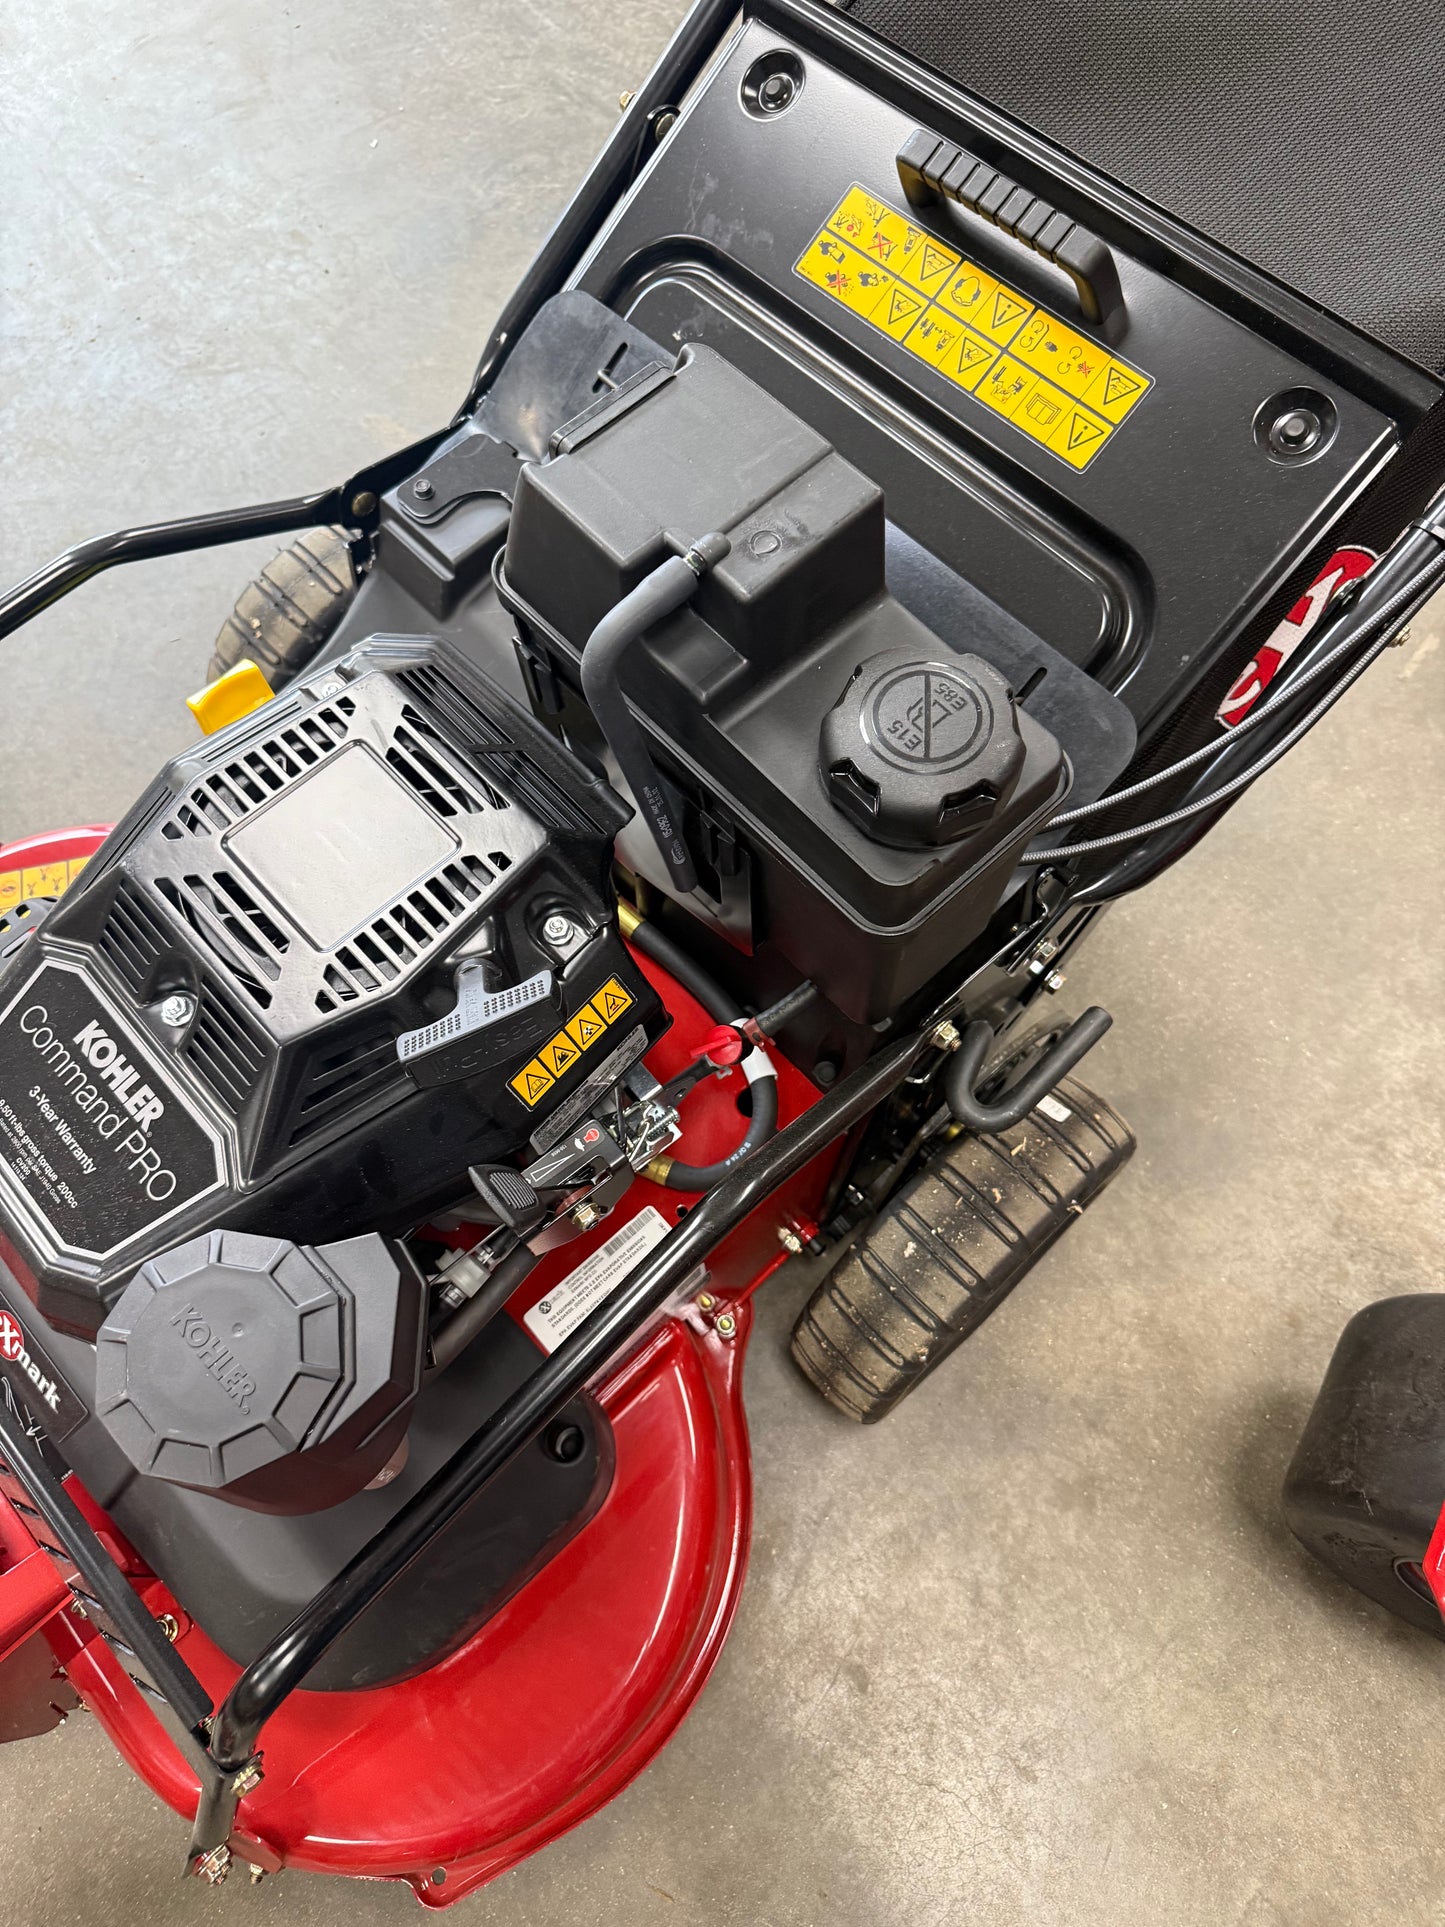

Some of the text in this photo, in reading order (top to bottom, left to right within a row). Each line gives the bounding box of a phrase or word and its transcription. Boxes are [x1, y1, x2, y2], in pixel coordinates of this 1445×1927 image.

[934, 680, 967, 713] E85
[887, 717, 921, 752] E15
[20, 1005, 177, 1202] Command PRO
[28, 1085, 97, 1174] 3-Year Warranty
[0, 1098, 80, 1209] 9.50 ft-lbs gross torque 200cc
[15, 1156, 31, 1176] CV200
[30, 1163, 42, 1176] SAE
[48, 1188, 62, 1204] Gross
[555, 1295, 577, 1315] EQUIPMENT
[576, 1285, 589, 1297] MEETS
[594, 1273, 603, 1281] EPA
[585, 1288, 594, 1297] NOT
[592, 1279, 604, 1290] MEET
[612, 1262, 623, 1272] EVAP
